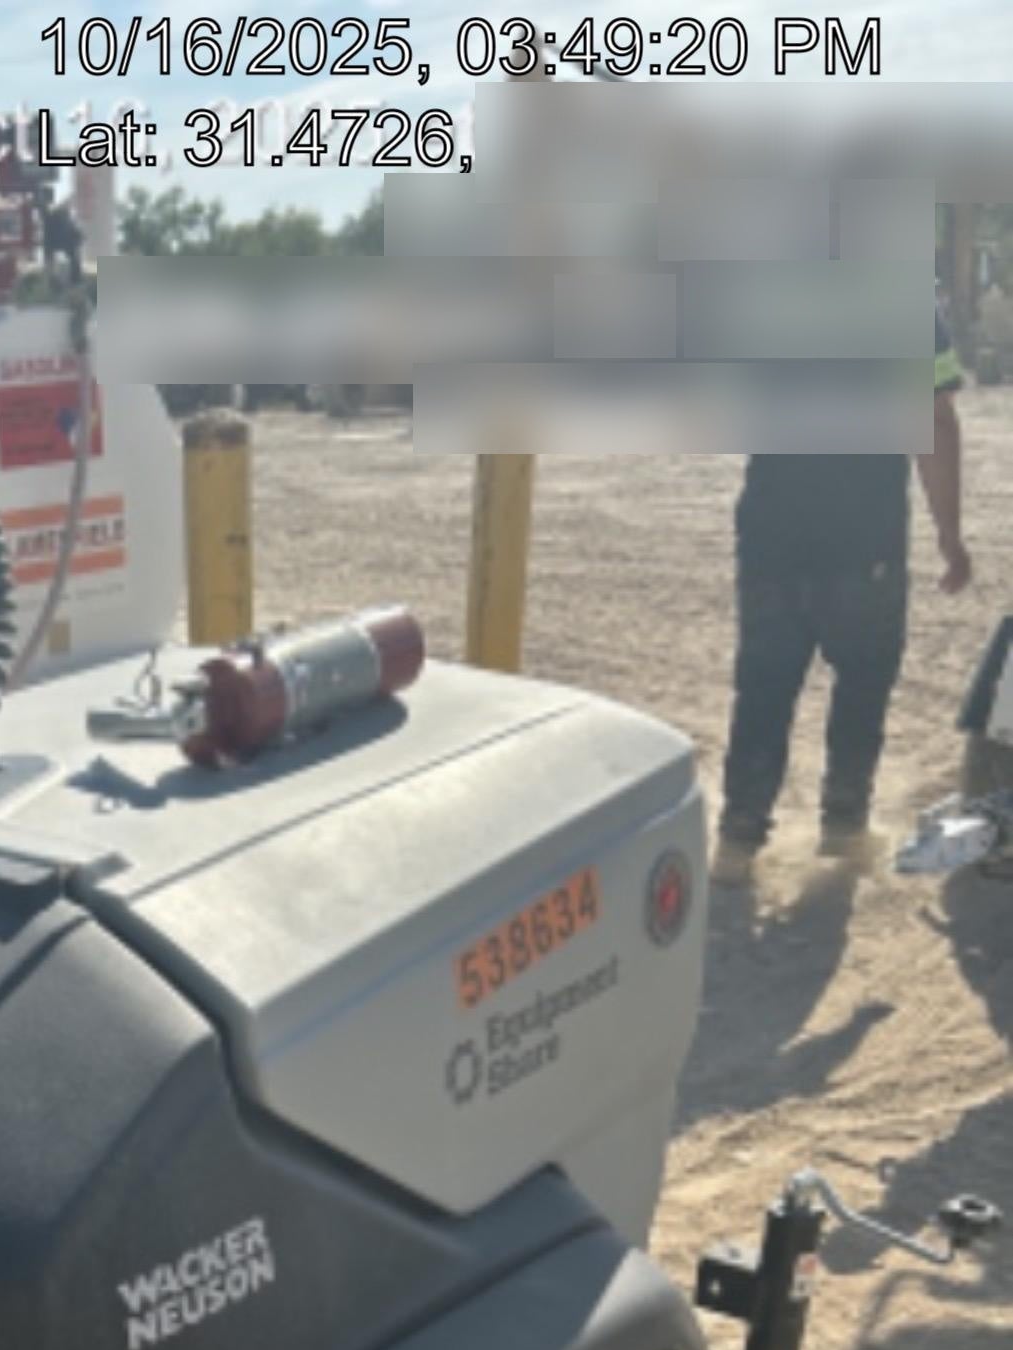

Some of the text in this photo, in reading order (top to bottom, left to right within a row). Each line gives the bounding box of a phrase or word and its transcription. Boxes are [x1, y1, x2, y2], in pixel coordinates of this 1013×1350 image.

[460, 867, 597, 1009] 538634
[117, 1216, 269, 1314] WACKER
[128, 1243, 276, 1350] NEUSON
